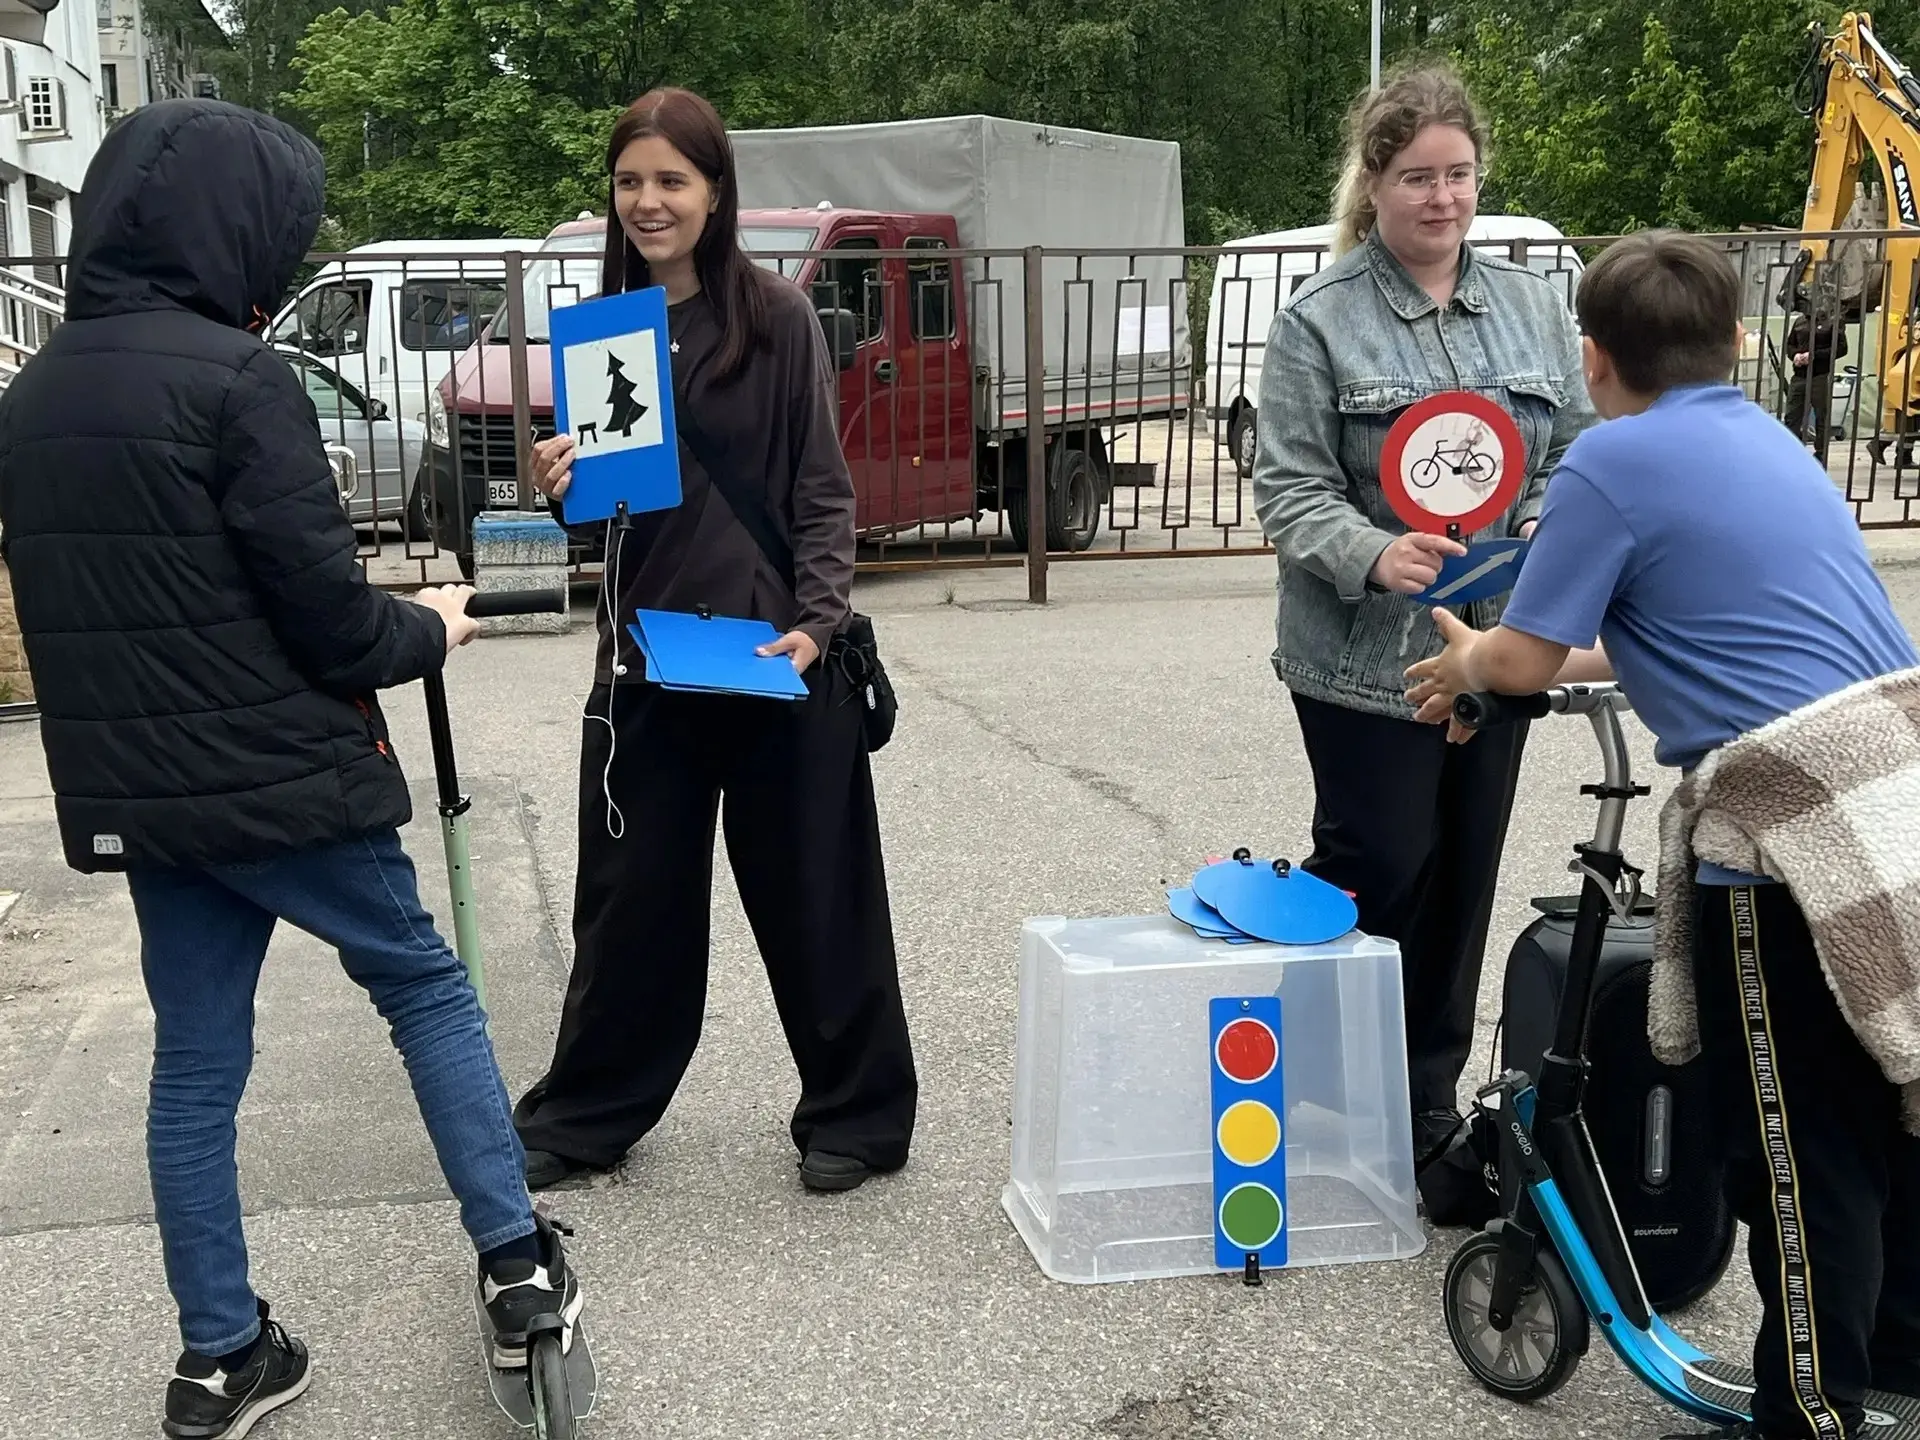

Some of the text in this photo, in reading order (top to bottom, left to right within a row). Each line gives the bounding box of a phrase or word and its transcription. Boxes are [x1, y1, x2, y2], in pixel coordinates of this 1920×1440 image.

[1894, 164, 1914, 220] SANY
[1740, 950, 1763, 1020] INFLUENCER
[1751, 1032, 1777, 1102] INFLUENCER
[1511, 1122, 1533, 1155] oxelo
[1766, 1114, 1791, 1183] INFLUENCER
[1633, 1225, 1678, 1236] soundcore
[1777, 1194, 1802, 1264] INFLUENCER
[1788, 1275, 1809, 1343] INFLUENCER
